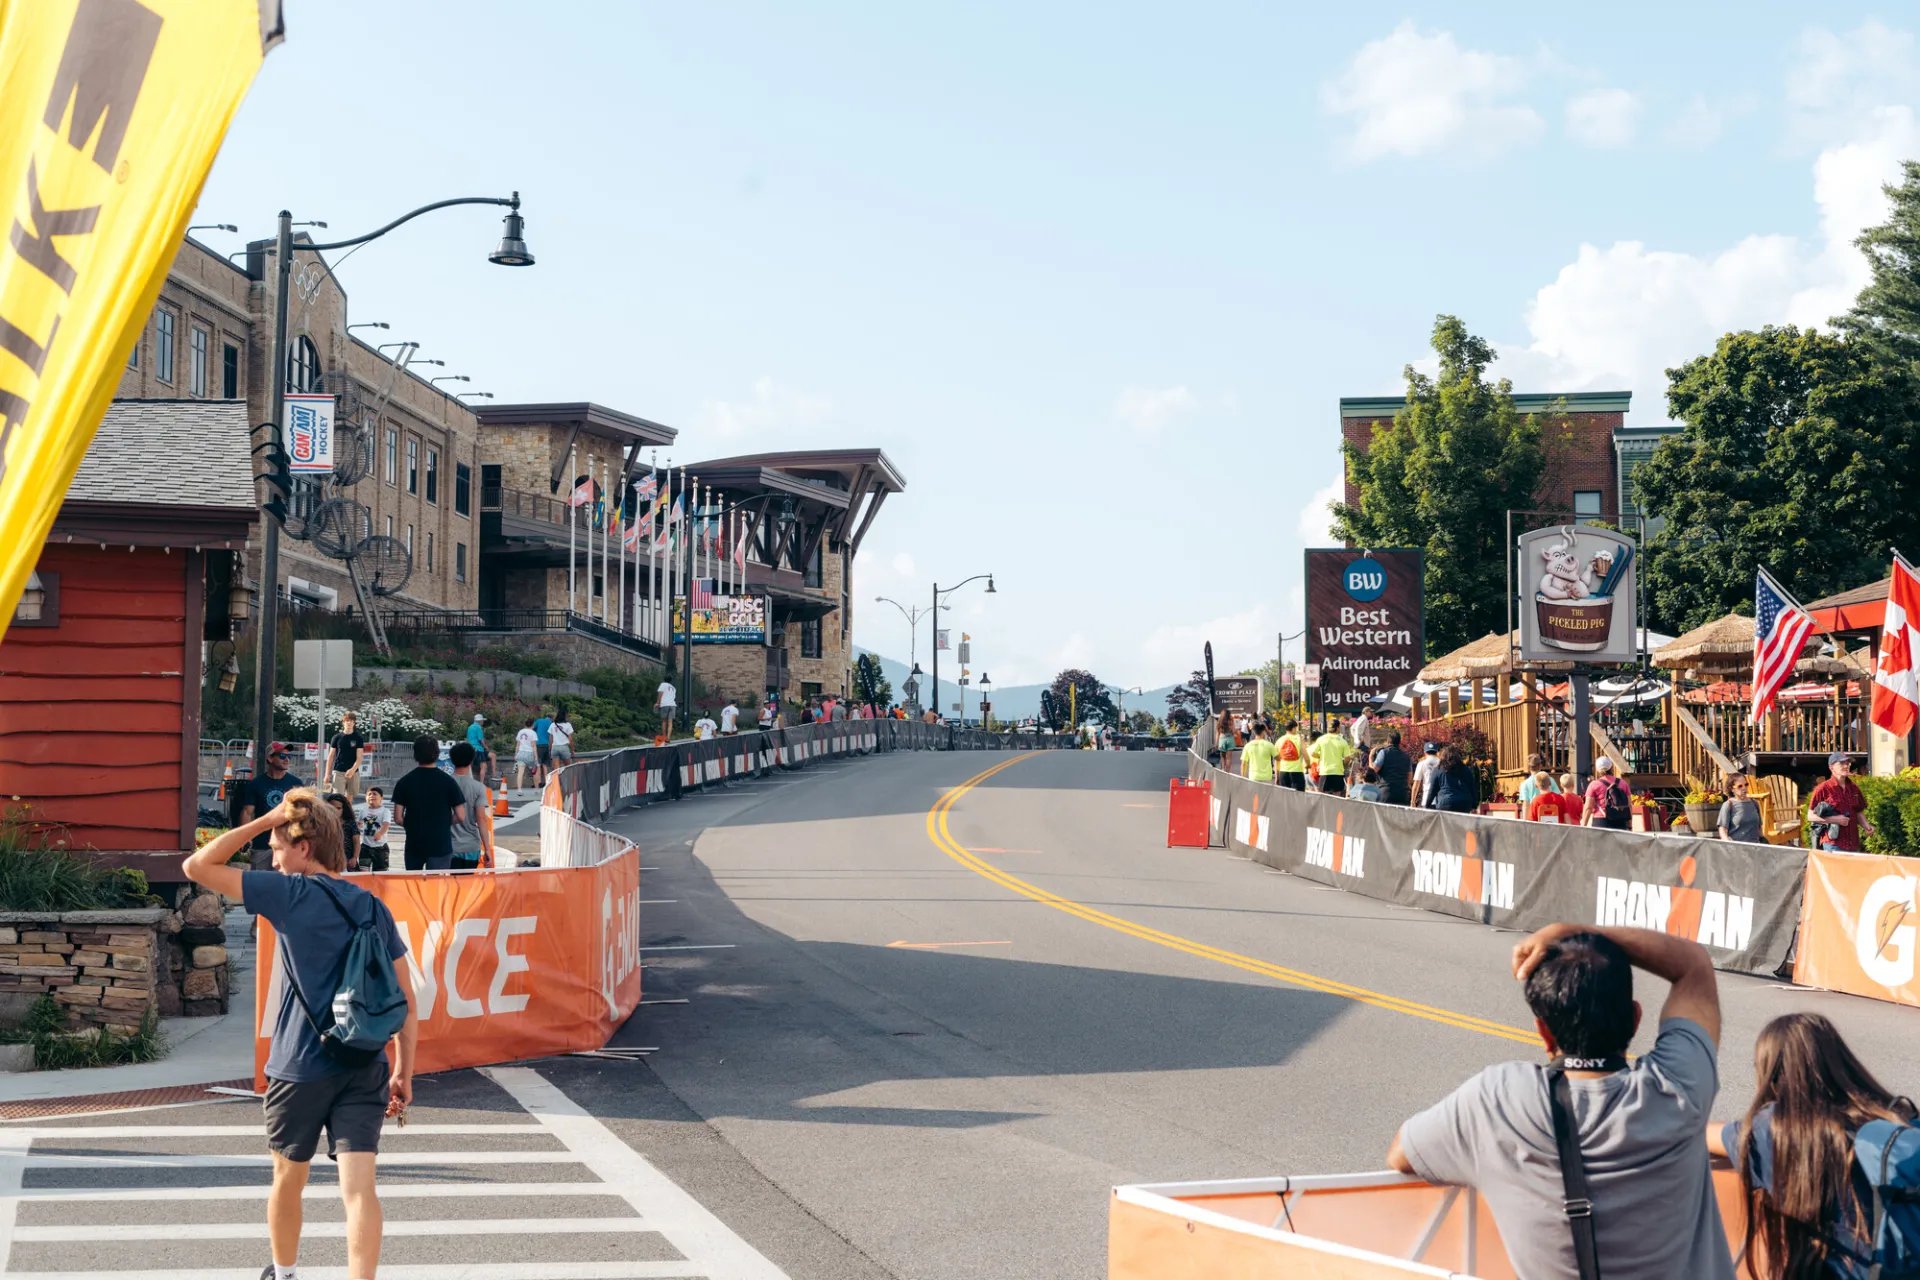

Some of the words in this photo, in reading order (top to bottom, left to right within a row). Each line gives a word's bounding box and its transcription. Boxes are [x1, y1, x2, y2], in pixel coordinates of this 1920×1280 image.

[319, 415, 328, 455] HOCKEY
[1349, 572, 1382, 590] BW
[728, 598, 764, 613] DISC
[1571, 608, 1584, 617] THE
[728, 613, 764, 626] GOLF
[1340, 606, 1390, 626] Best
[1548, 616, 1588, 630] PICKLED
[1590, 617, 1605, 629] PIG
[1319, 626, 1412, 646] Western
[1321, 656, 1411, 670] Adirondack
[1353, 673, 1380, 686] Inn
[1345, 690, 1370, 703] the
[1304, 810, 1366, 878] IRONMAN
[1412, 831, 1515, 910] IRONMAN
[1595, 855, 1755, 951] IRONMAN
[1856, 875, 1919, 987] G
[1564, 1057, 1606, 1068] SONY
